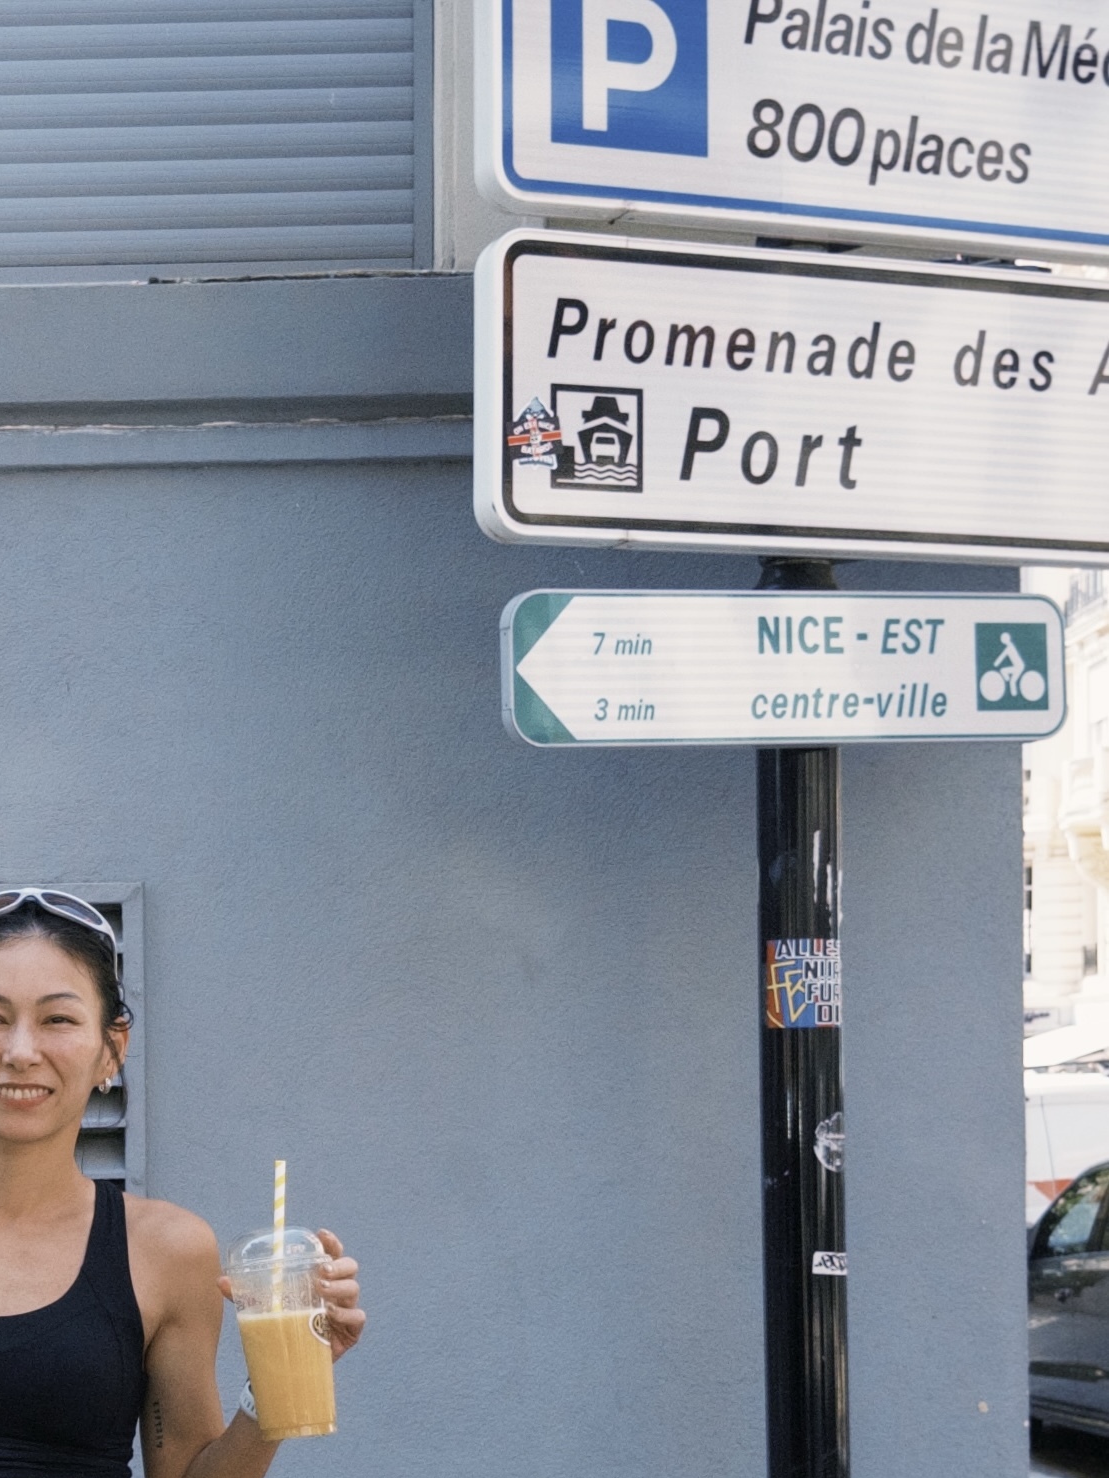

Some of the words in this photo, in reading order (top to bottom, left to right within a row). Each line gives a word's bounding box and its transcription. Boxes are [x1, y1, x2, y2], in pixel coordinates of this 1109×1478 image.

[582, 0, 678, 132] P
[744, 0, 894, 60] Palais
[906, 8, 963, 68] de
[973, 14, 1013, 74] la
[747, 99, 865, 166] 800
[869, 115, 1031, 186] places
[547, 298, 916, 381] Promenade
[954, 330, 1054, 392] des
[680, 407, 862, 489] Port
[593, 632, 605, 655] 7
[615, 633, 653, 655] min
[758, 616, 844, 655] NICE
[881, 619, 945, 654] EST
[594, 698, 609, 721] 3
[617, 699, 656, 721] min
[752, 683, 948, 720] centre-ville
